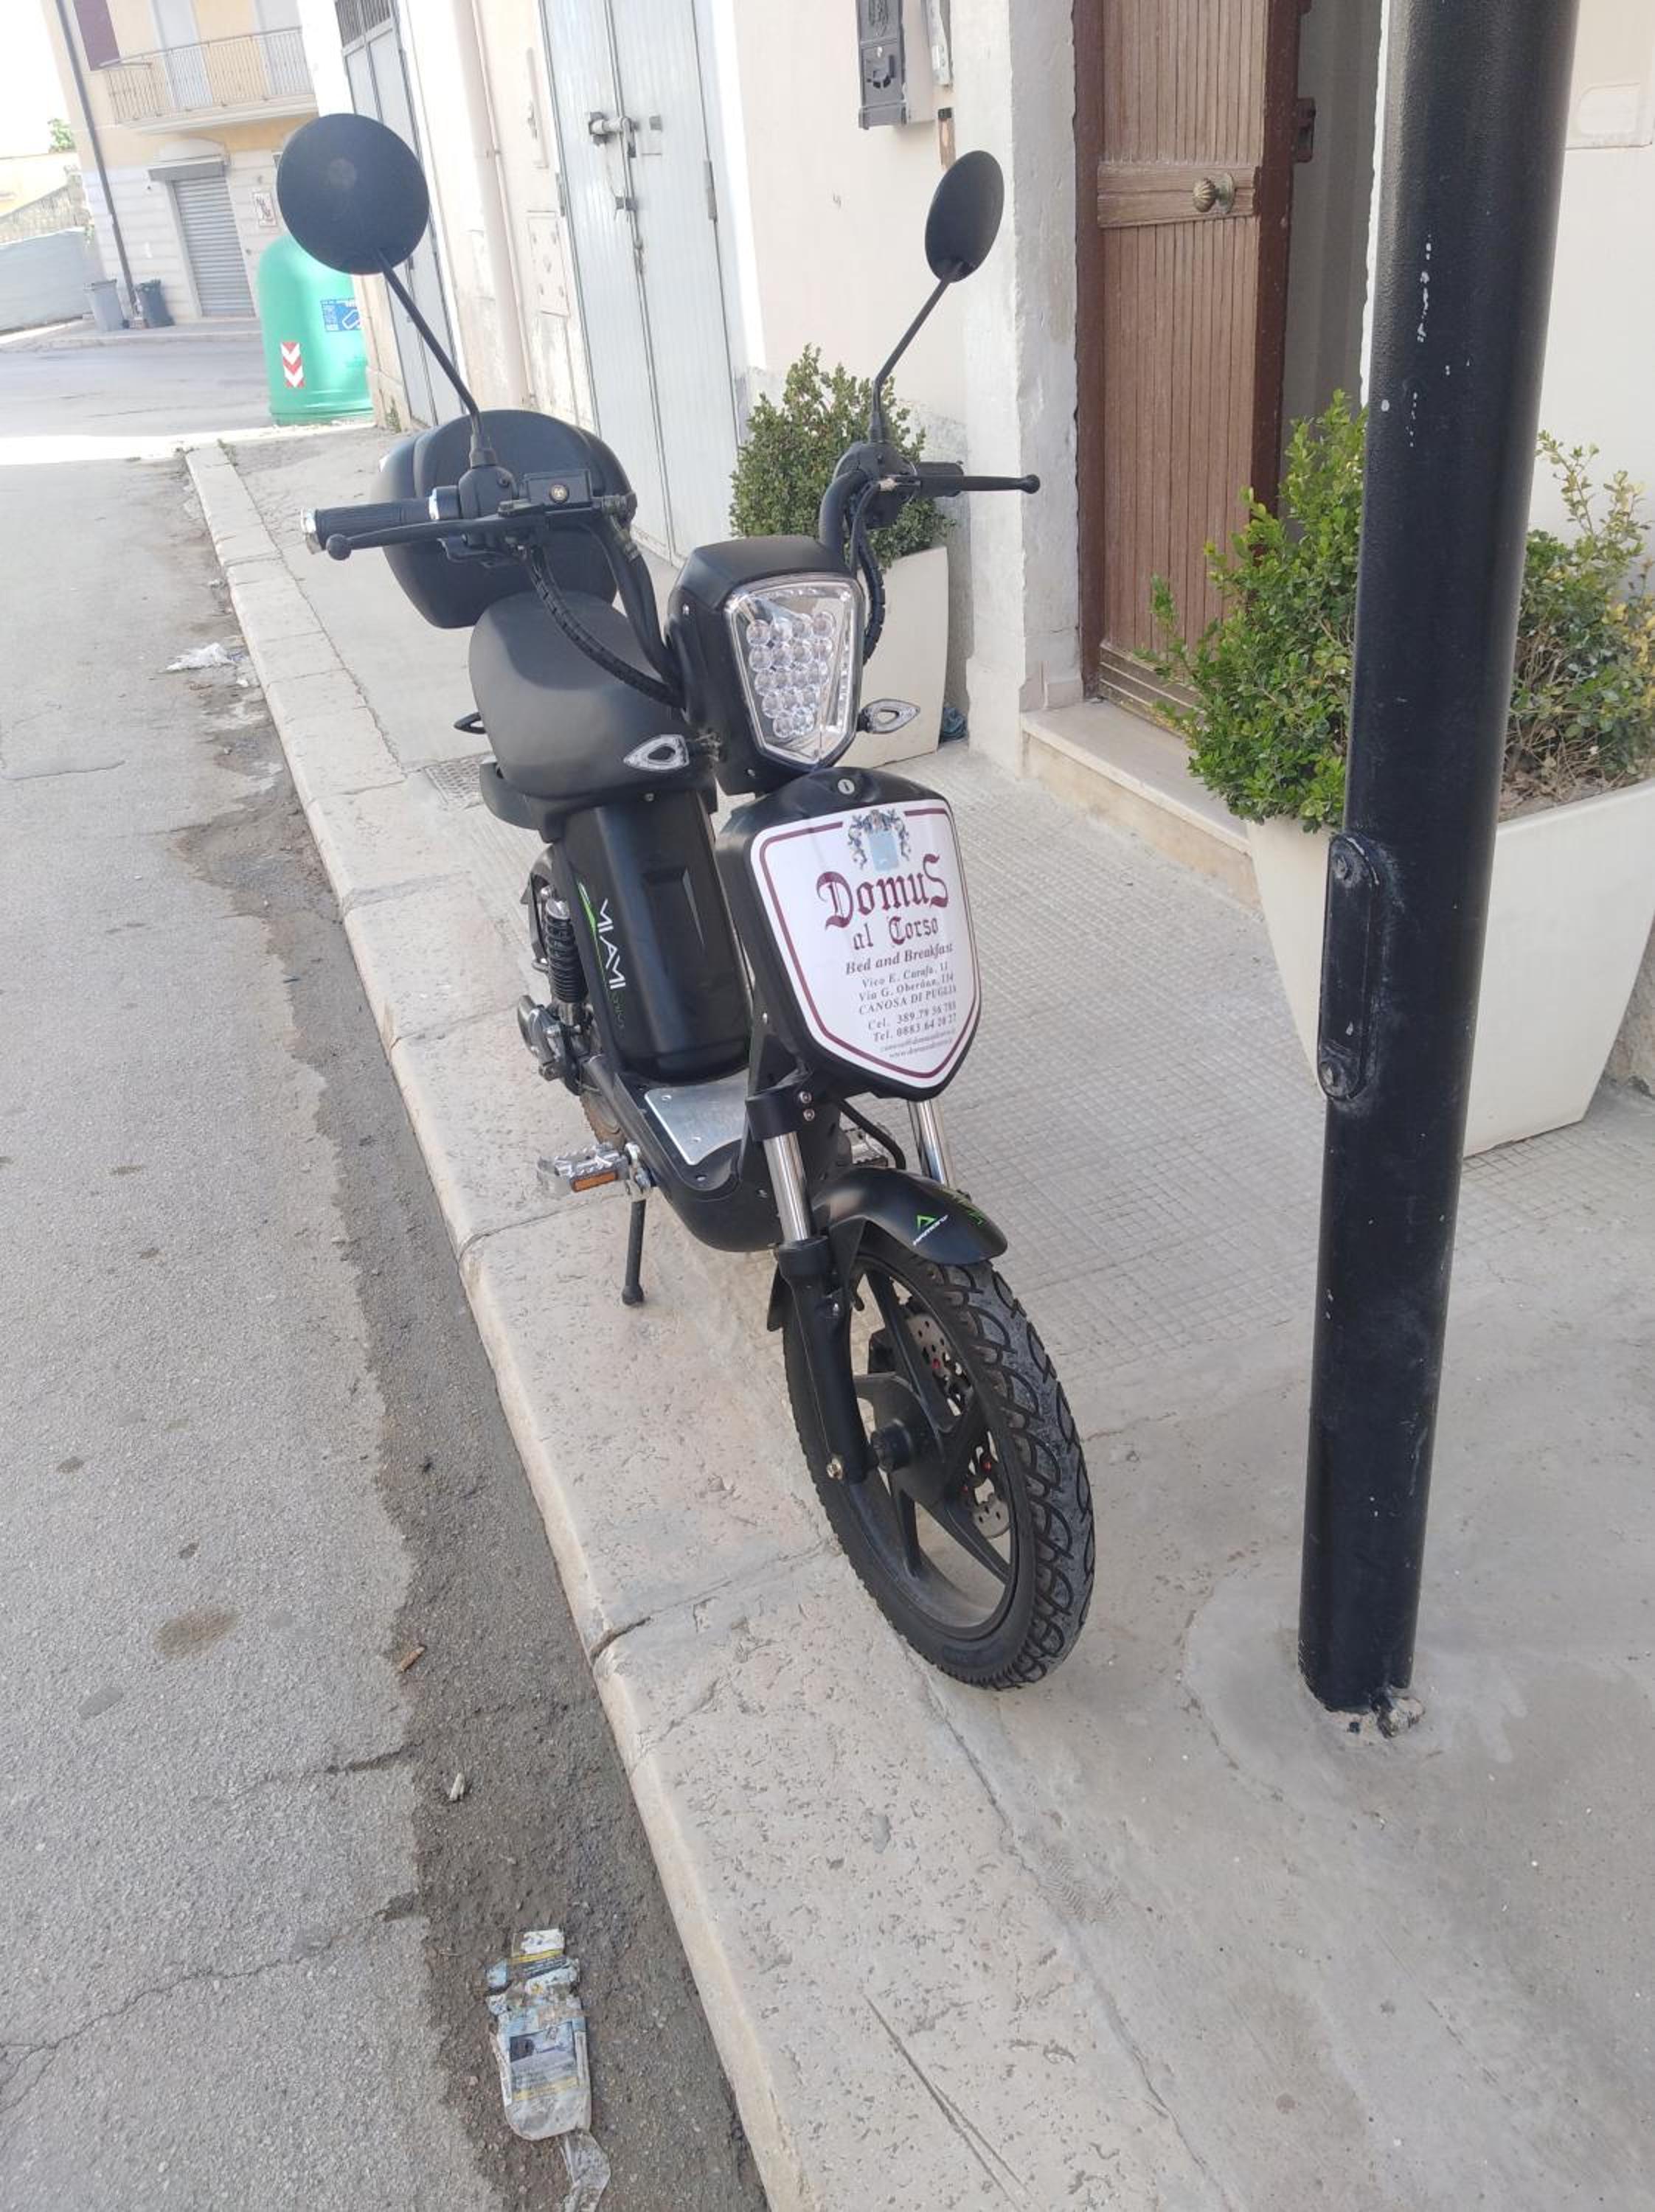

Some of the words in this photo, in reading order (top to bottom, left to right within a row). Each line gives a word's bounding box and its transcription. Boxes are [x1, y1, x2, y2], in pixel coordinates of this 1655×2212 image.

[597, 899, 625, 990] MIAMI
[853, 924, 874, 950] al
[889, 916, 939, 946] Corso
[846, 959, 871, 975] Bed
[875, 952, 901, 968] and
[905, 943, 954, 963] Breakfast
[859, 992, 877, 1001] Via
[859, 997, 907, 1015] CANOSA
[912, 992, 923, 1004] DI
[926, 984, 957, 1001] PUGLIA
[873, 1030, 893, 1042] Tel.
